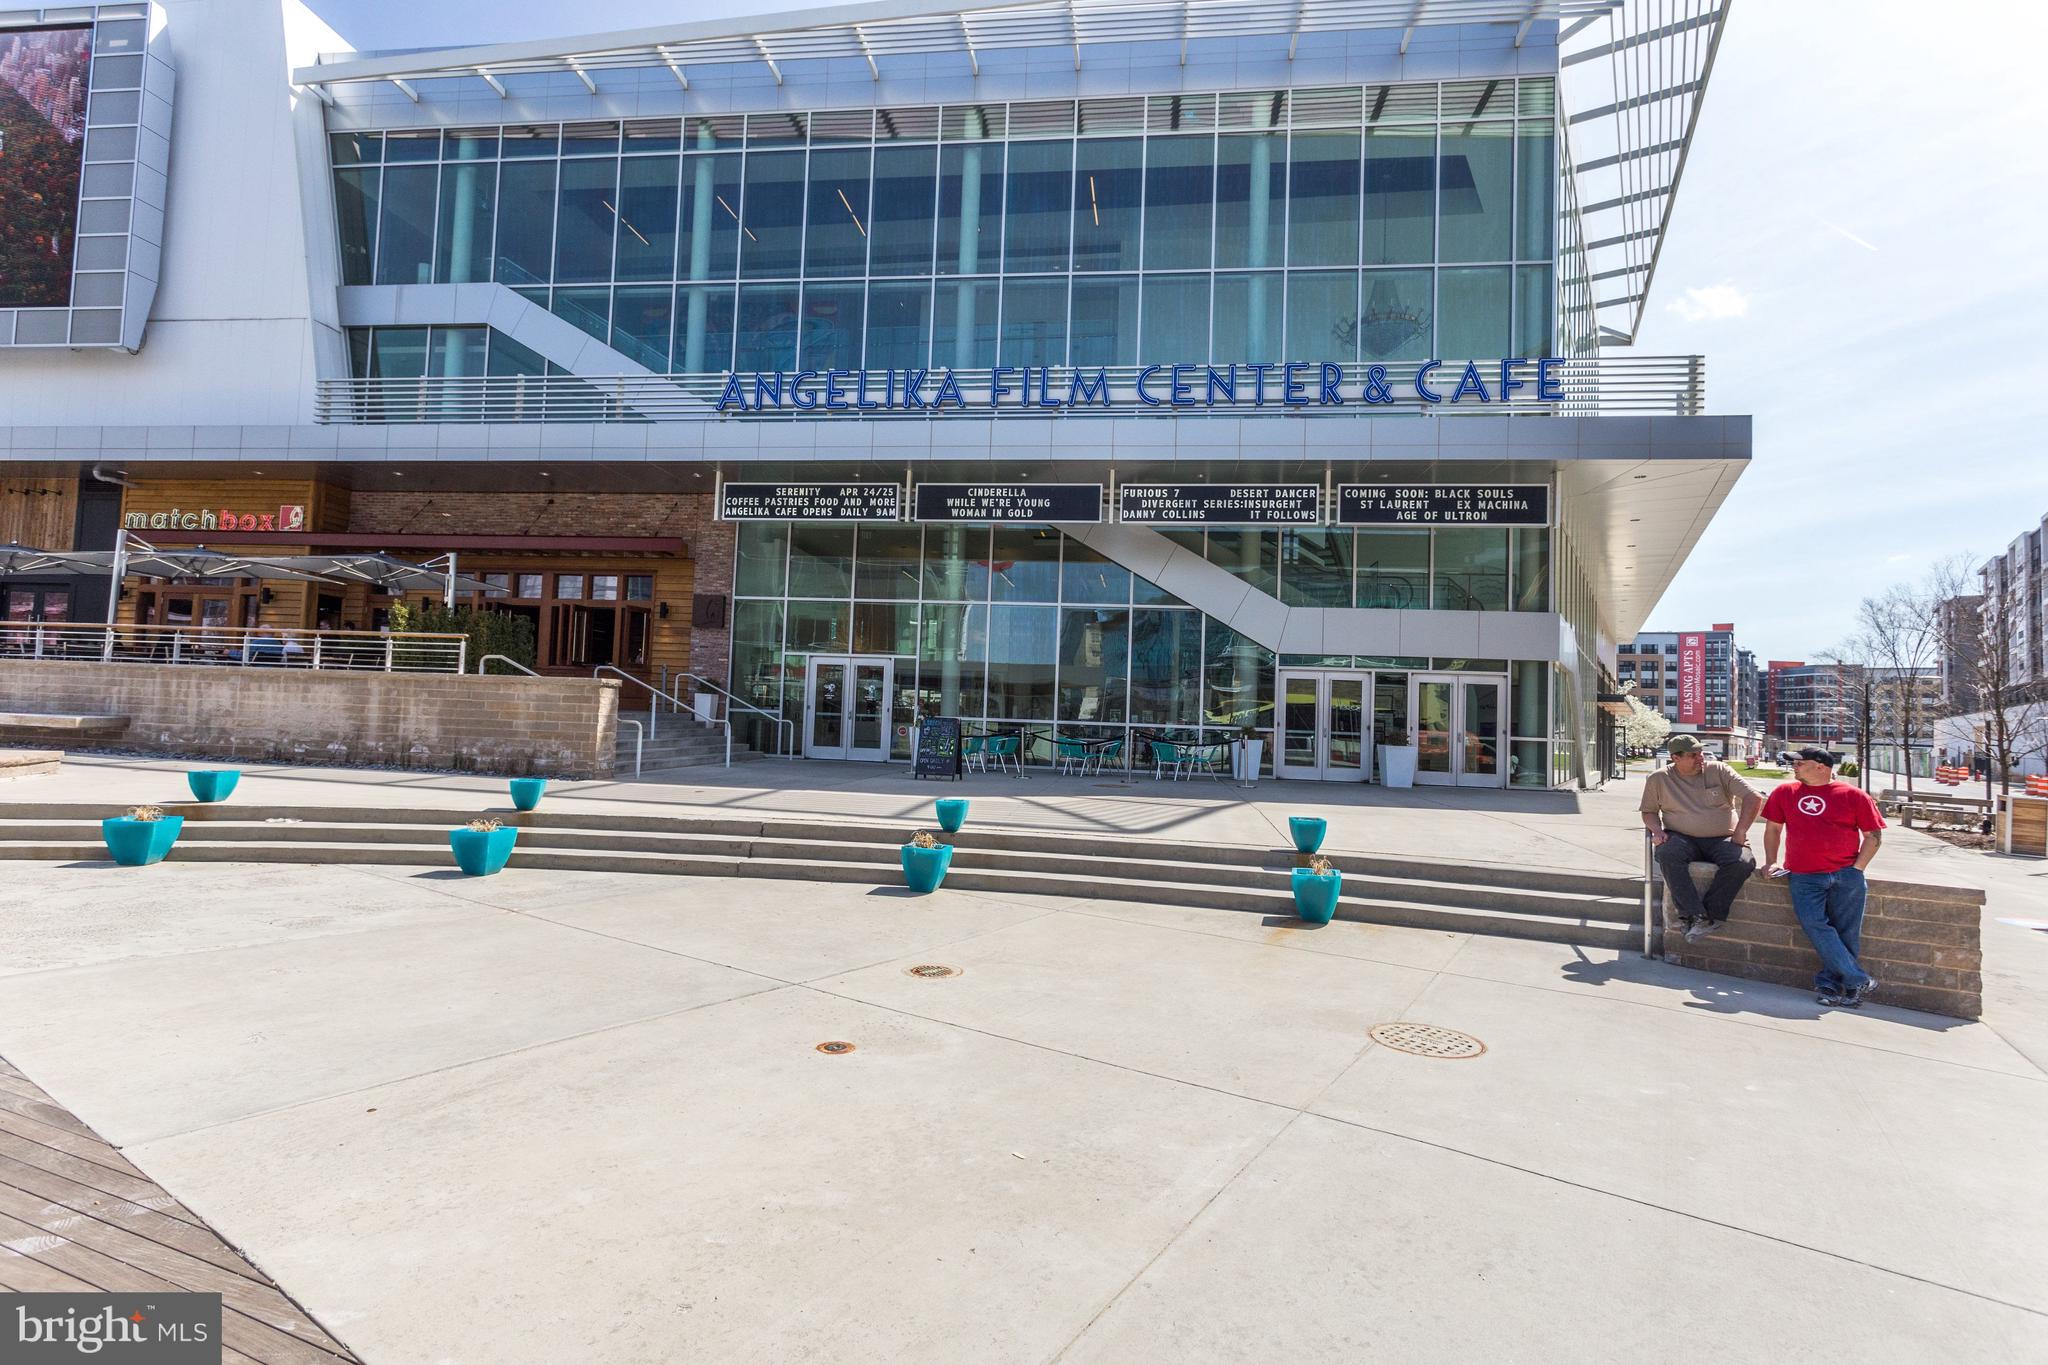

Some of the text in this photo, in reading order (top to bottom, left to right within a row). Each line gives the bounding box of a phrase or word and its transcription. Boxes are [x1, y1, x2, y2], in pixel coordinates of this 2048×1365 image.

[715, 357, 1567, 411] ANGELIKA FILM CENTER & CAFE
[775, 487, 894, 496] SERENITY APR 24/25
[967, 488, 1027, 497] CINDERELLA
[1123, 489, 1180, 498] FURIOUS 7
[1230, 489, 1316, 498] DESERT DANCER
[1344, 489, 1514, 498] COMING SOON: BLACK SOULS
[725, 497, 896, 507] COFFEE PASTRIES FOOD AND MORE
[946, 498, 1051, 508] WHILE WE'RE YOUNG
[1141, 499, 1197, 508] DIVERGENT
[1360, 499, 1430, 510] ST LAURENT
[1456, 500, 1529, 510] EX MACHINA
[725, 507, 896, 517] ANGELIKA CAFE OPENS DAILY 9AM
[951, 508, 1034, 518] WOMAN IN GOLD
[1123, 510, 1206, 519] DANNY COLLINS
[1250, 510, 1316, 520] IT FOLLOWS
[1396, 511, 1488, 521] AGE OF ULTRON
[124, 508, 275, 531] matchbox
[1683, 650, 1693, 715] LEASING APTS
